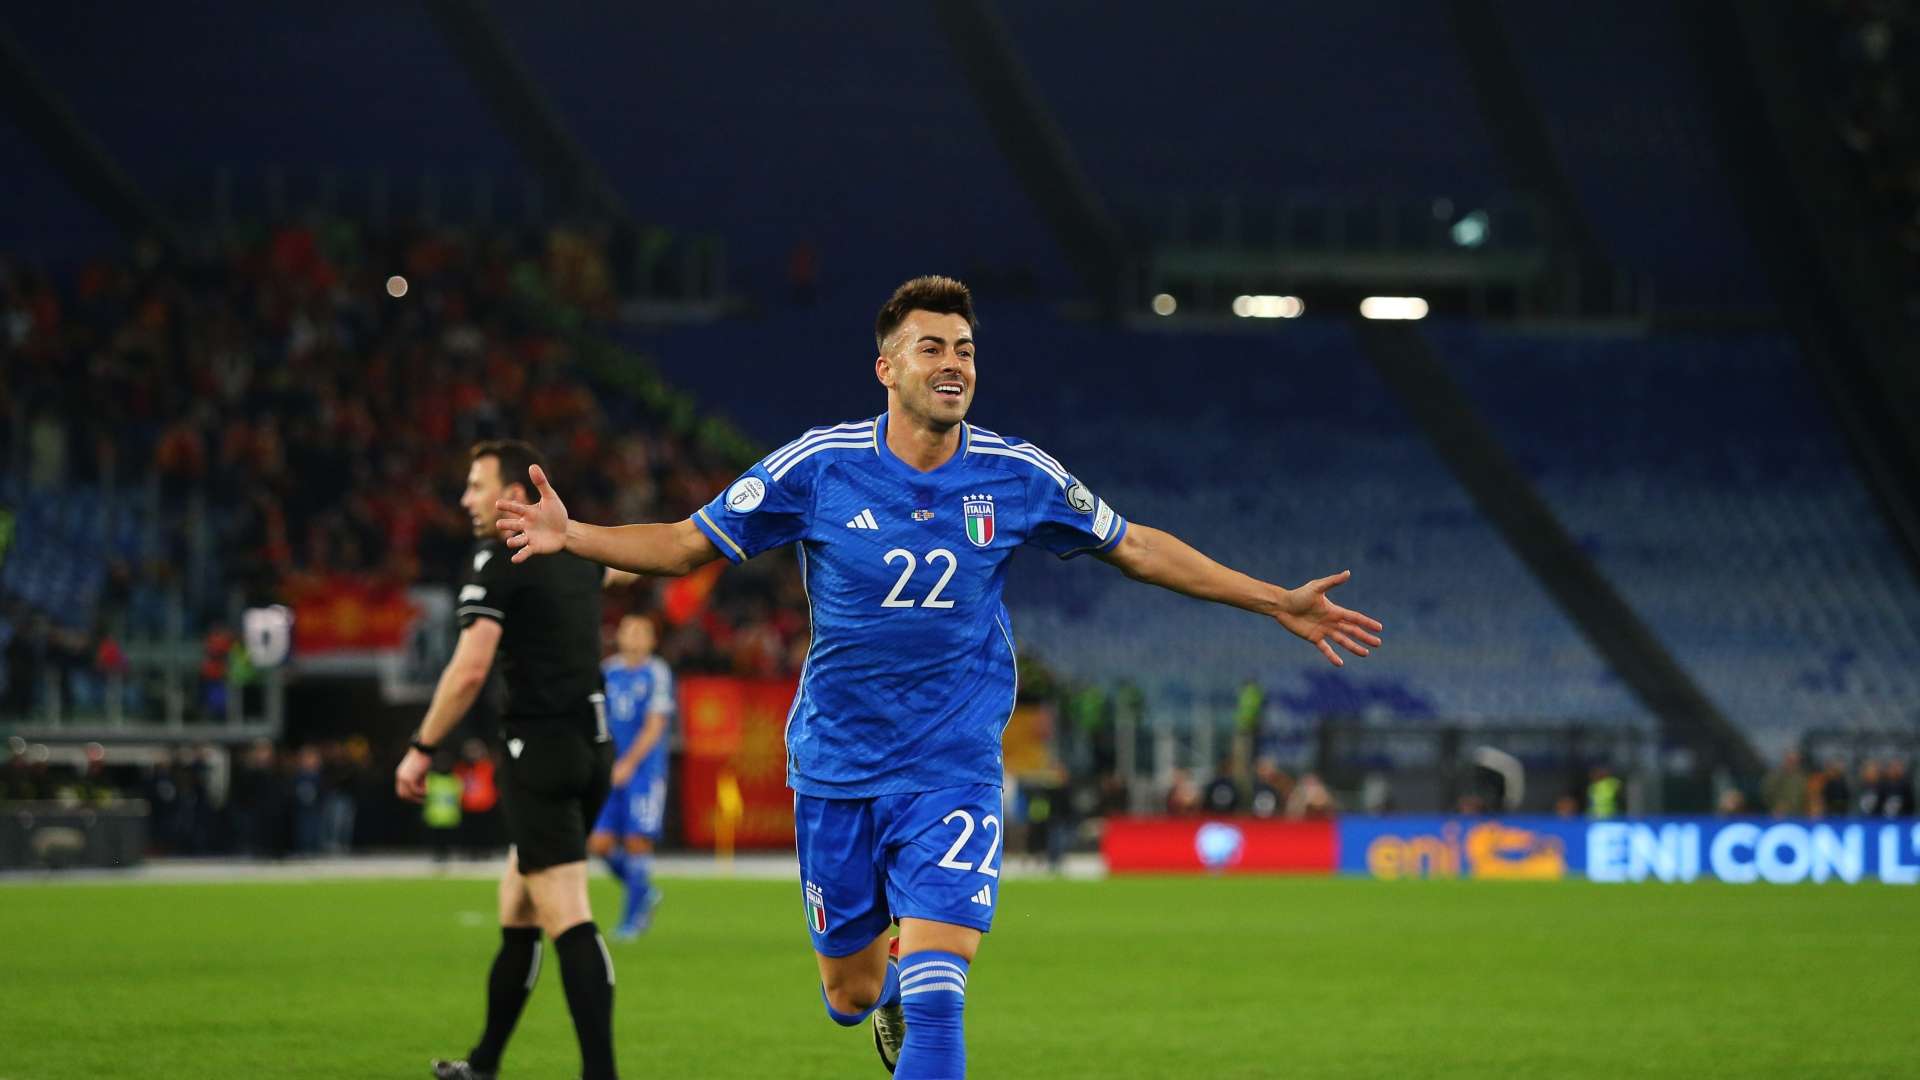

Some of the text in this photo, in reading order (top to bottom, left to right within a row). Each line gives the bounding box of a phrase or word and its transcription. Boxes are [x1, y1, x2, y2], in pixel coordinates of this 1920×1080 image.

[966, 505, 992, 515] ITALIA
[881, 548, 958, 609] 22
[937, 809, 1000, 879] 22
[1367, 821, 1461, 881] eni
[1587, 822, 1700, 883] ENI
[1710, 822, 1865, 884] CON
